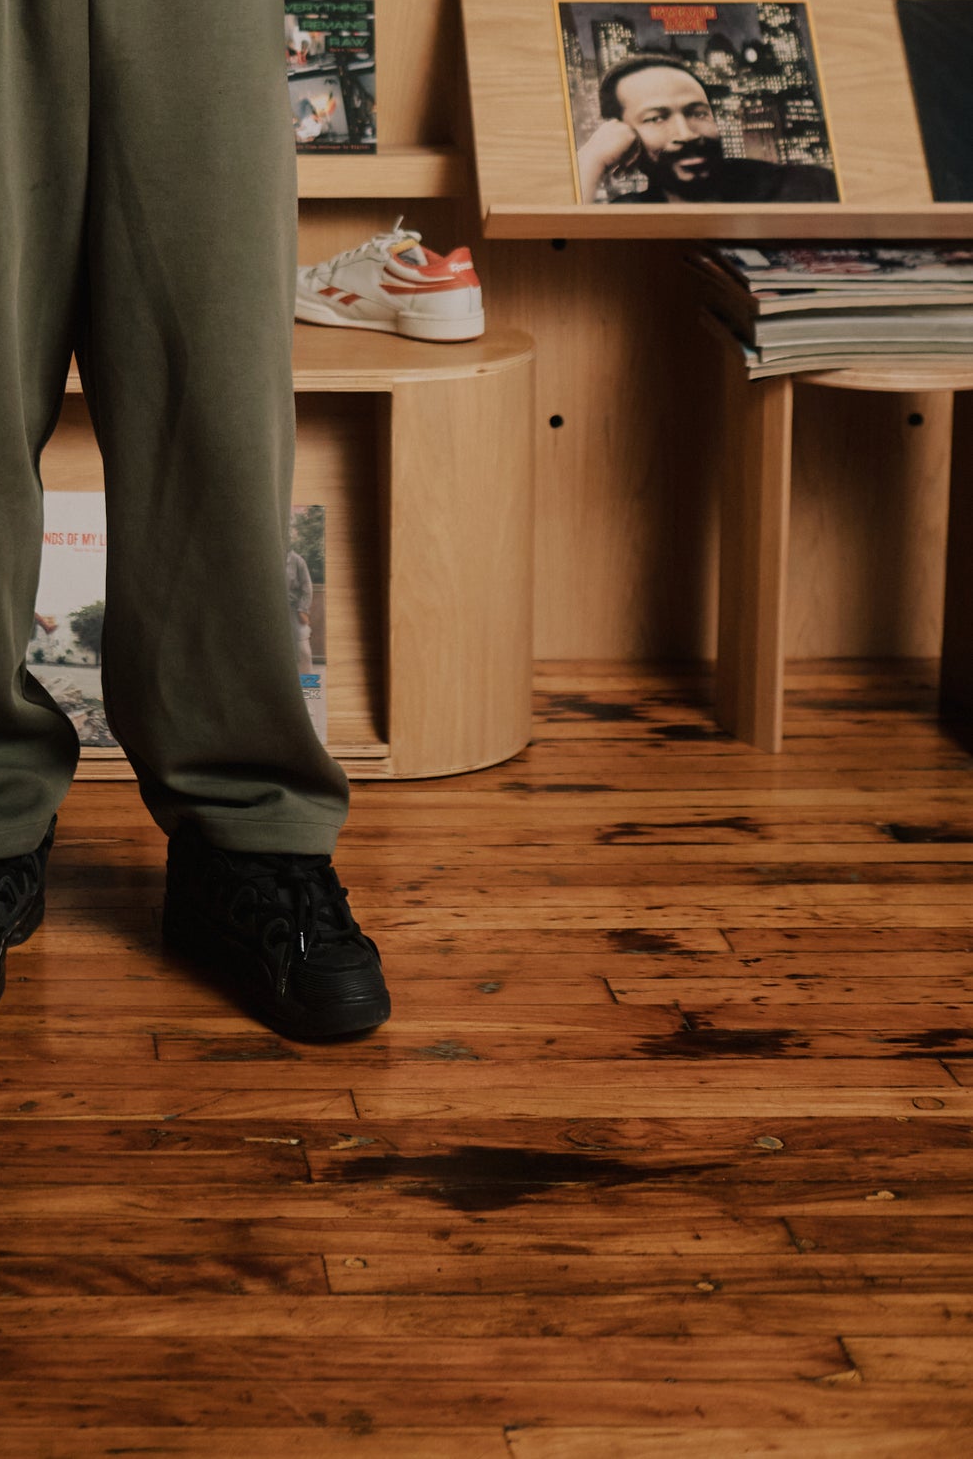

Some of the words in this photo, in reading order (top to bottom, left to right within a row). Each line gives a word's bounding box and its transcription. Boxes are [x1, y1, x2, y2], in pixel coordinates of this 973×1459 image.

[301, 21, 367, 32] REMAINS
[329, 36, 368, 47] RAW
[67, 532, 78, 546] OF
[82, 533, 96, 546] MY
